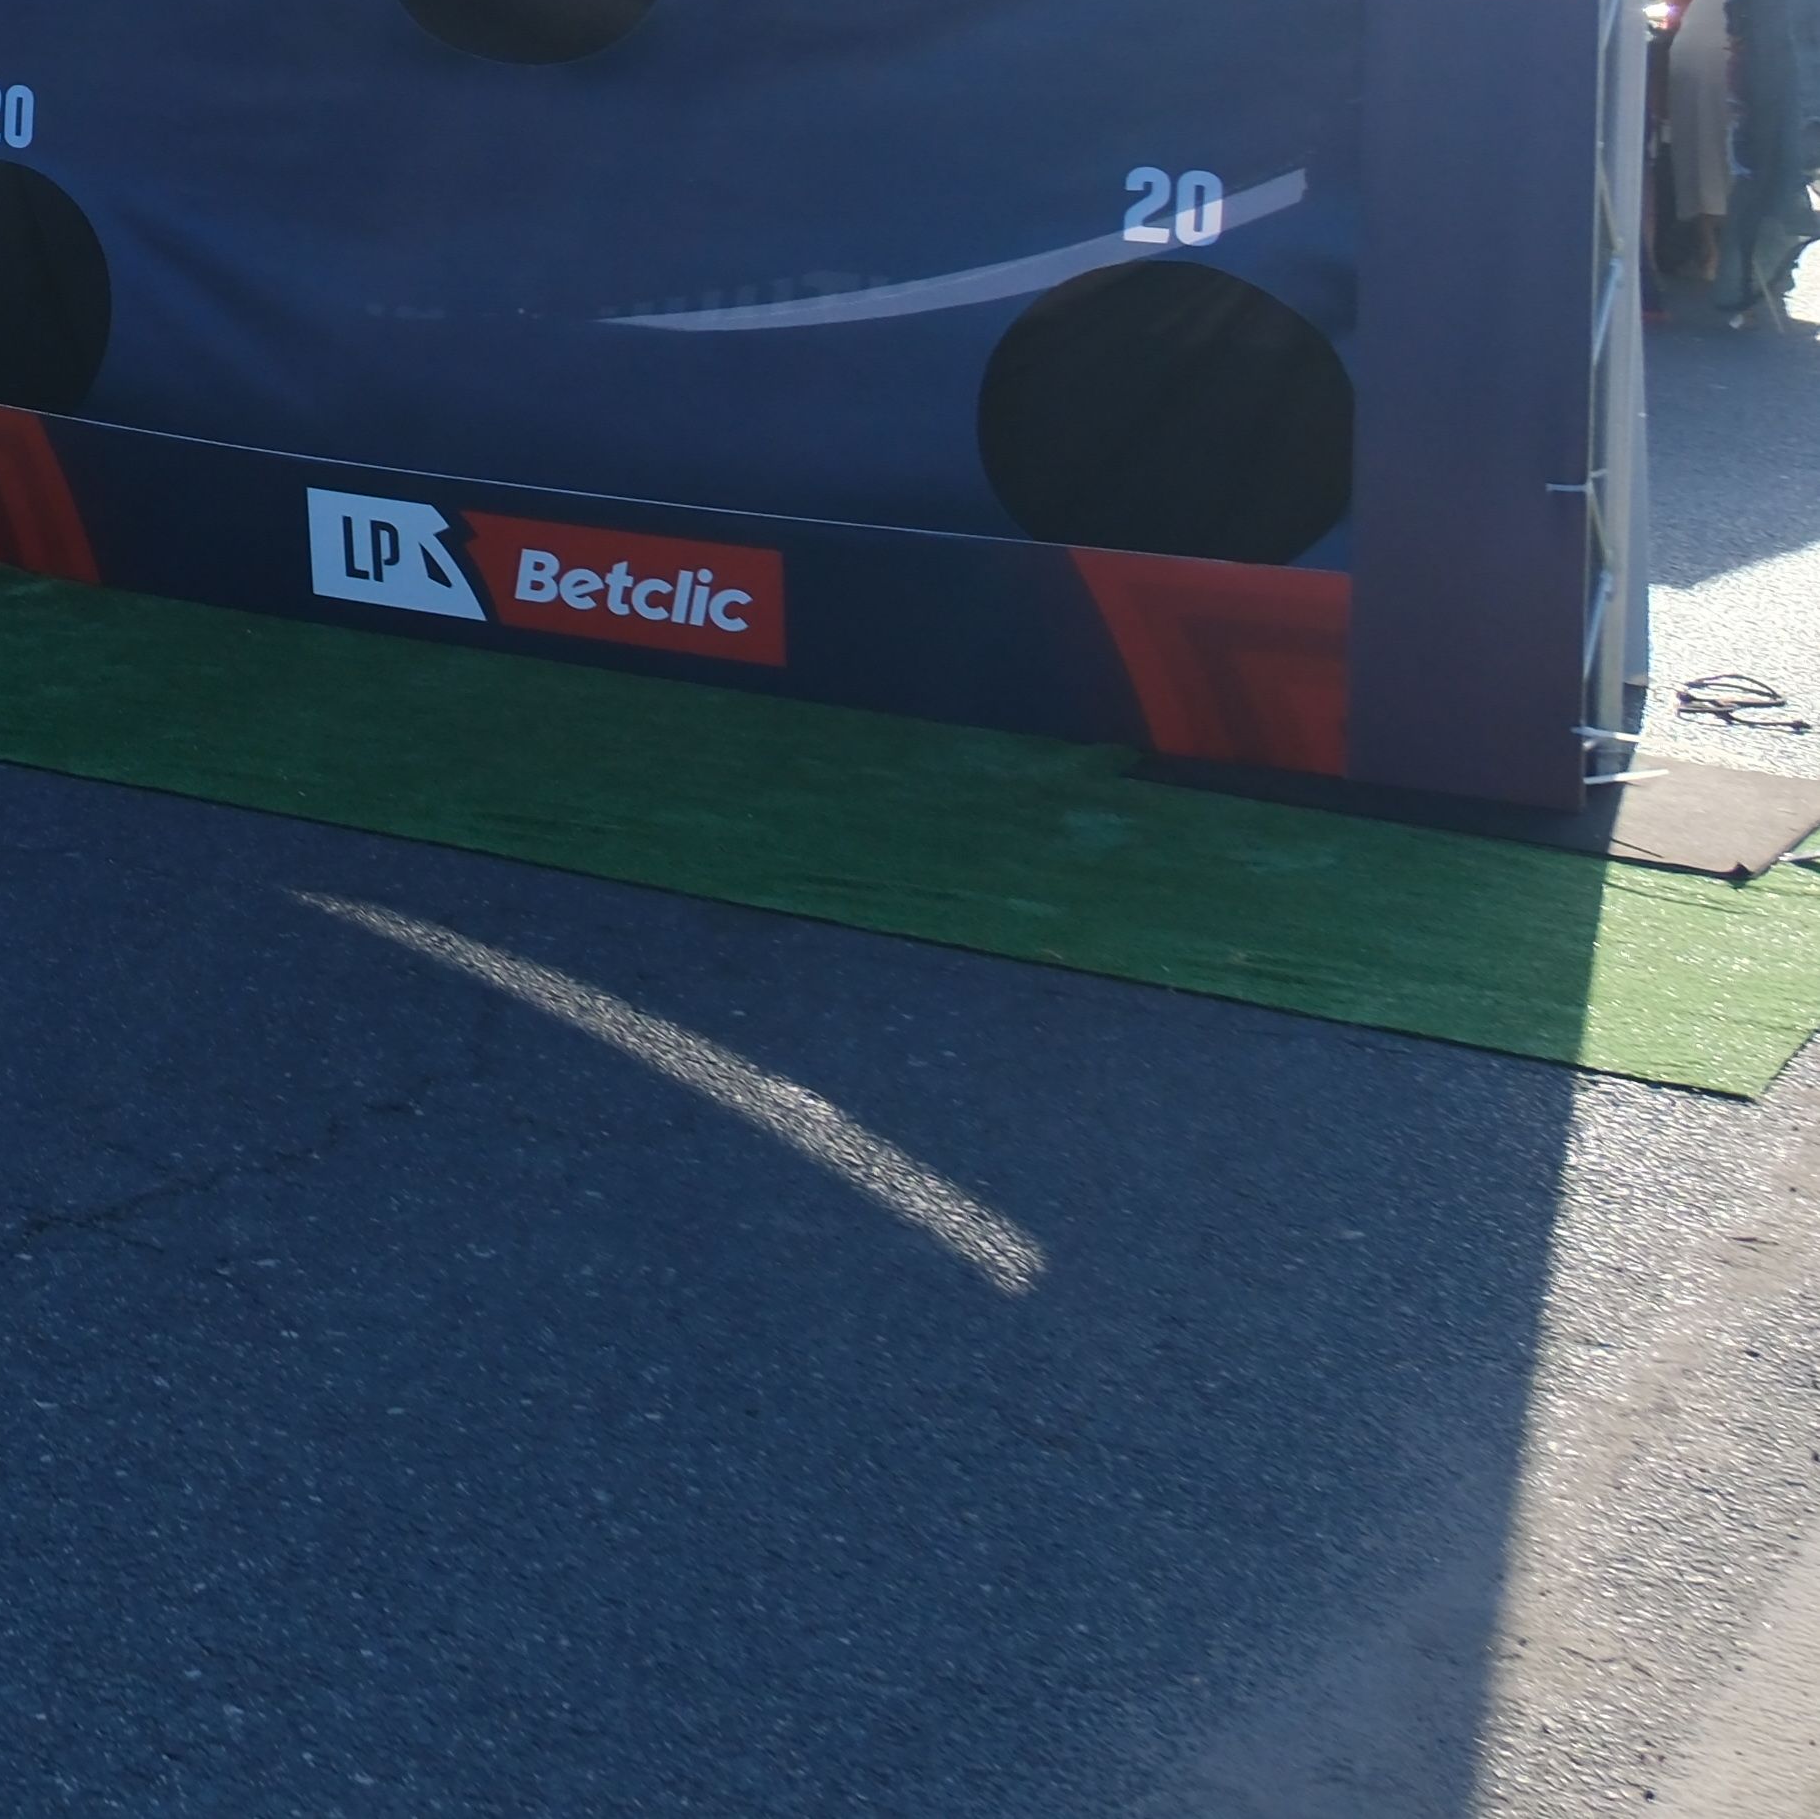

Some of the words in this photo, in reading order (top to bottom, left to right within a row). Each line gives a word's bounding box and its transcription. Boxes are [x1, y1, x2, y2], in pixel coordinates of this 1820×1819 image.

[1123, 166, 1223, 247] 20
[341, 515, 401, 583] LP
[514, 548, 754, 632] Betclic
